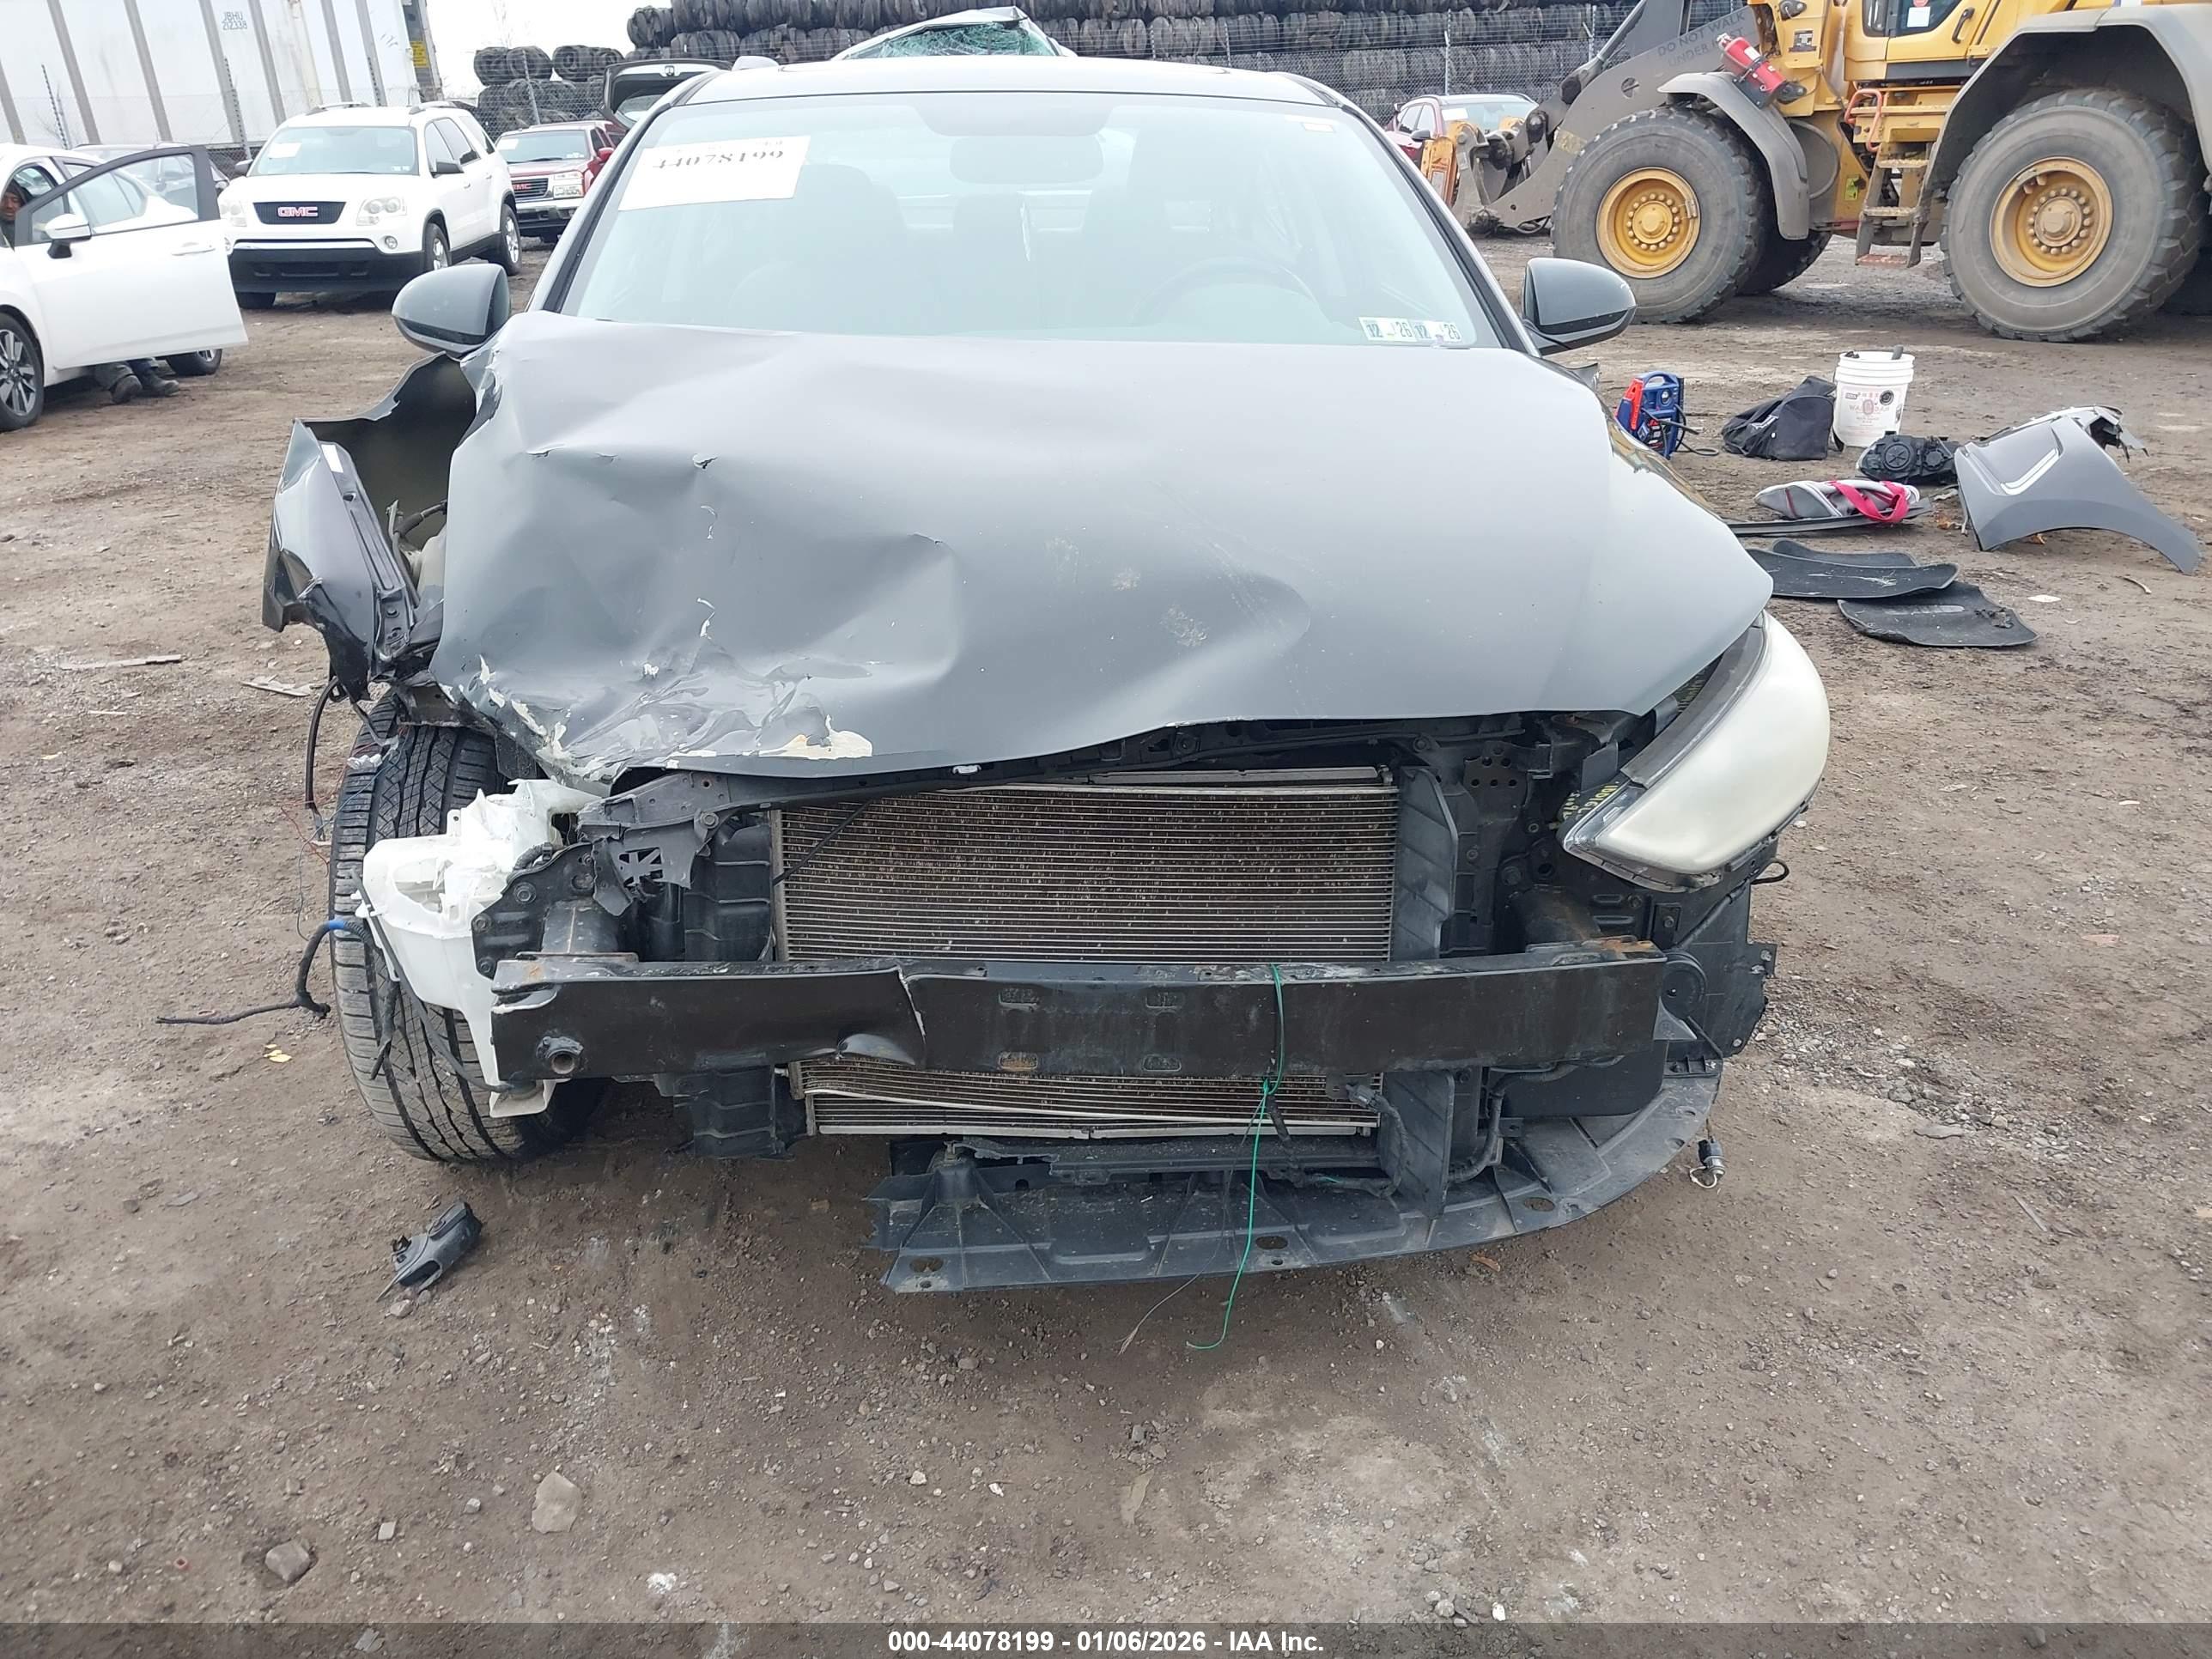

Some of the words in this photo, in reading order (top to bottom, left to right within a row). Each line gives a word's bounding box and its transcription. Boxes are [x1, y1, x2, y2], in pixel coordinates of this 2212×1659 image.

[1657, 41, 1675, 57] DO
[1679, 28, 1705, 47] NOT
[1707, 11, 1746, 33] WALK
[1668, 44, 1710, 68] UNDER
[277, 206, 319, 217] GMC
